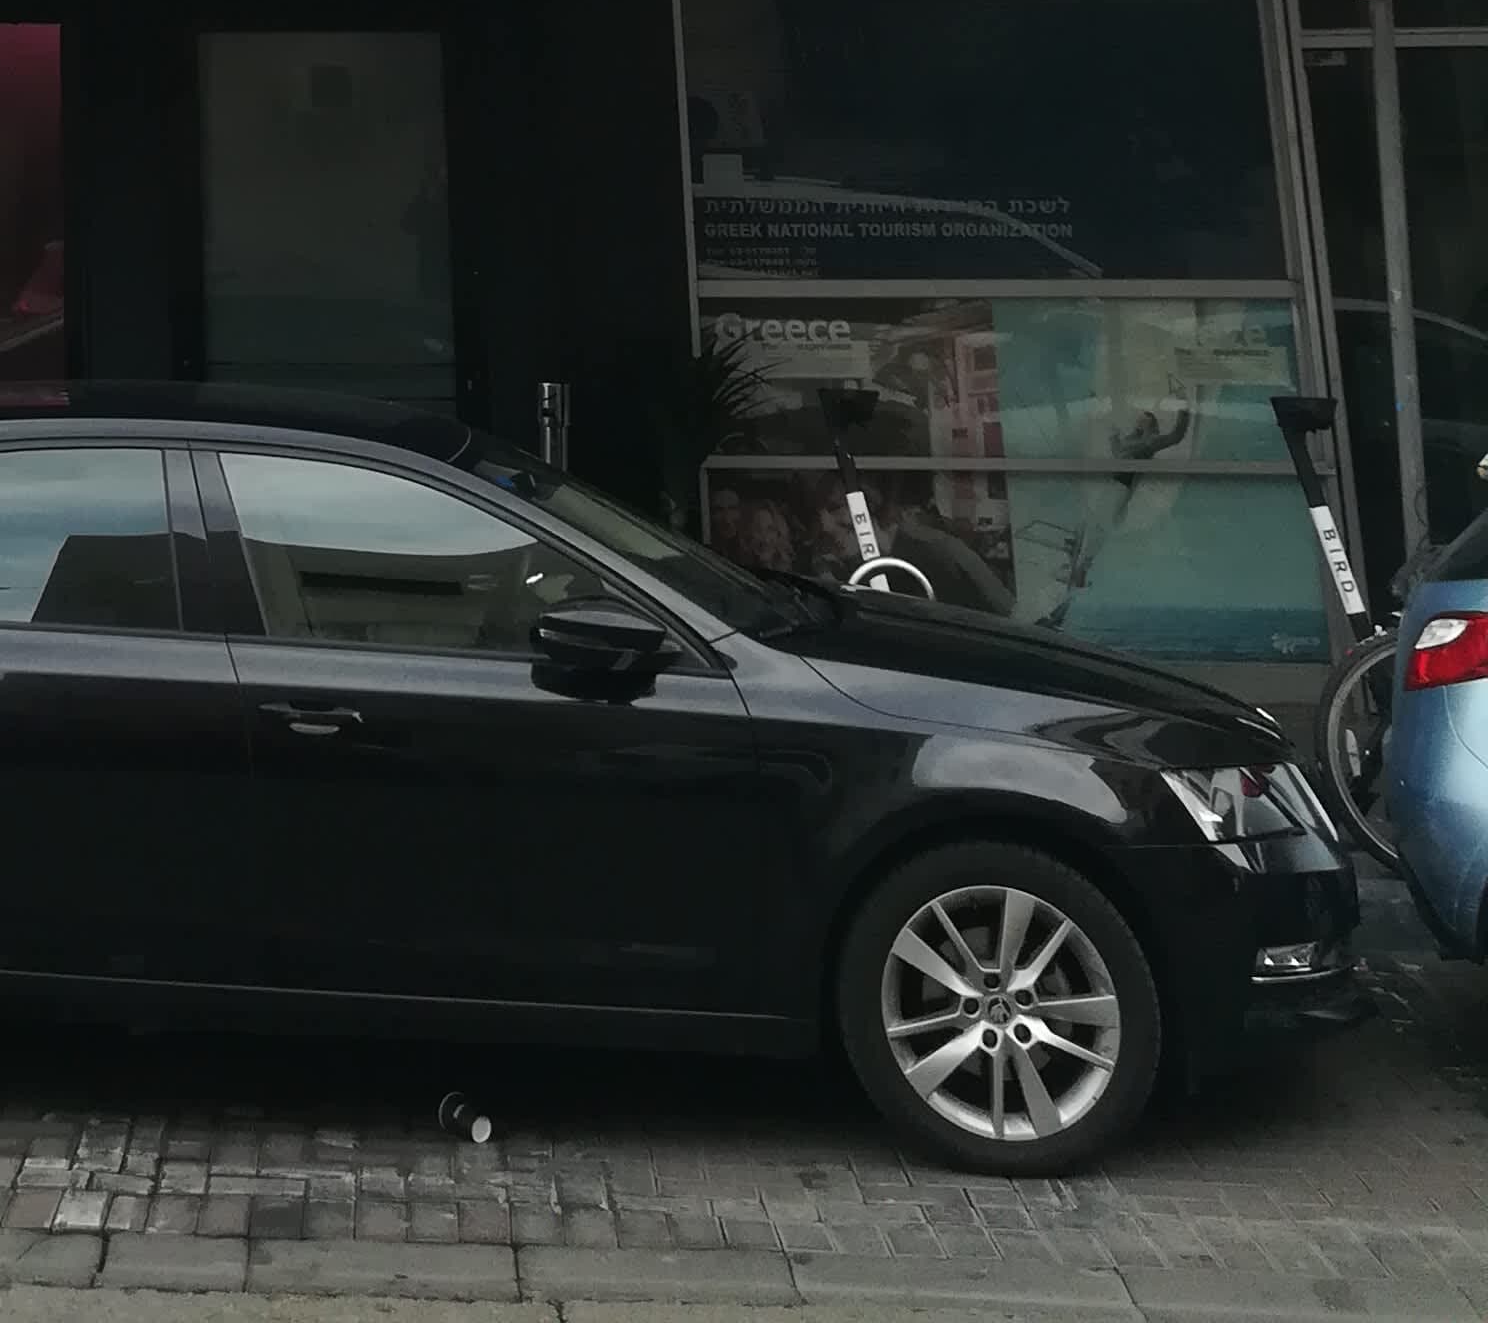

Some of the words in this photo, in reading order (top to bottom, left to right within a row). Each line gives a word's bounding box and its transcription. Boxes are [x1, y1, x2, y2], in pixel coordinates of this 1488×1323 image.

[704, 222, 763, 238] GREEK
[766, 222, 855, 238] NATIONAL
[858, 222, 937, 238] TOURISM
[941, 222, 1073, 238] ORGANIZATION
[714, 312, 852, 342] Greece
[853, 511, 878, 557] BIR
[1322, 528, 1356, 594] BIRD
